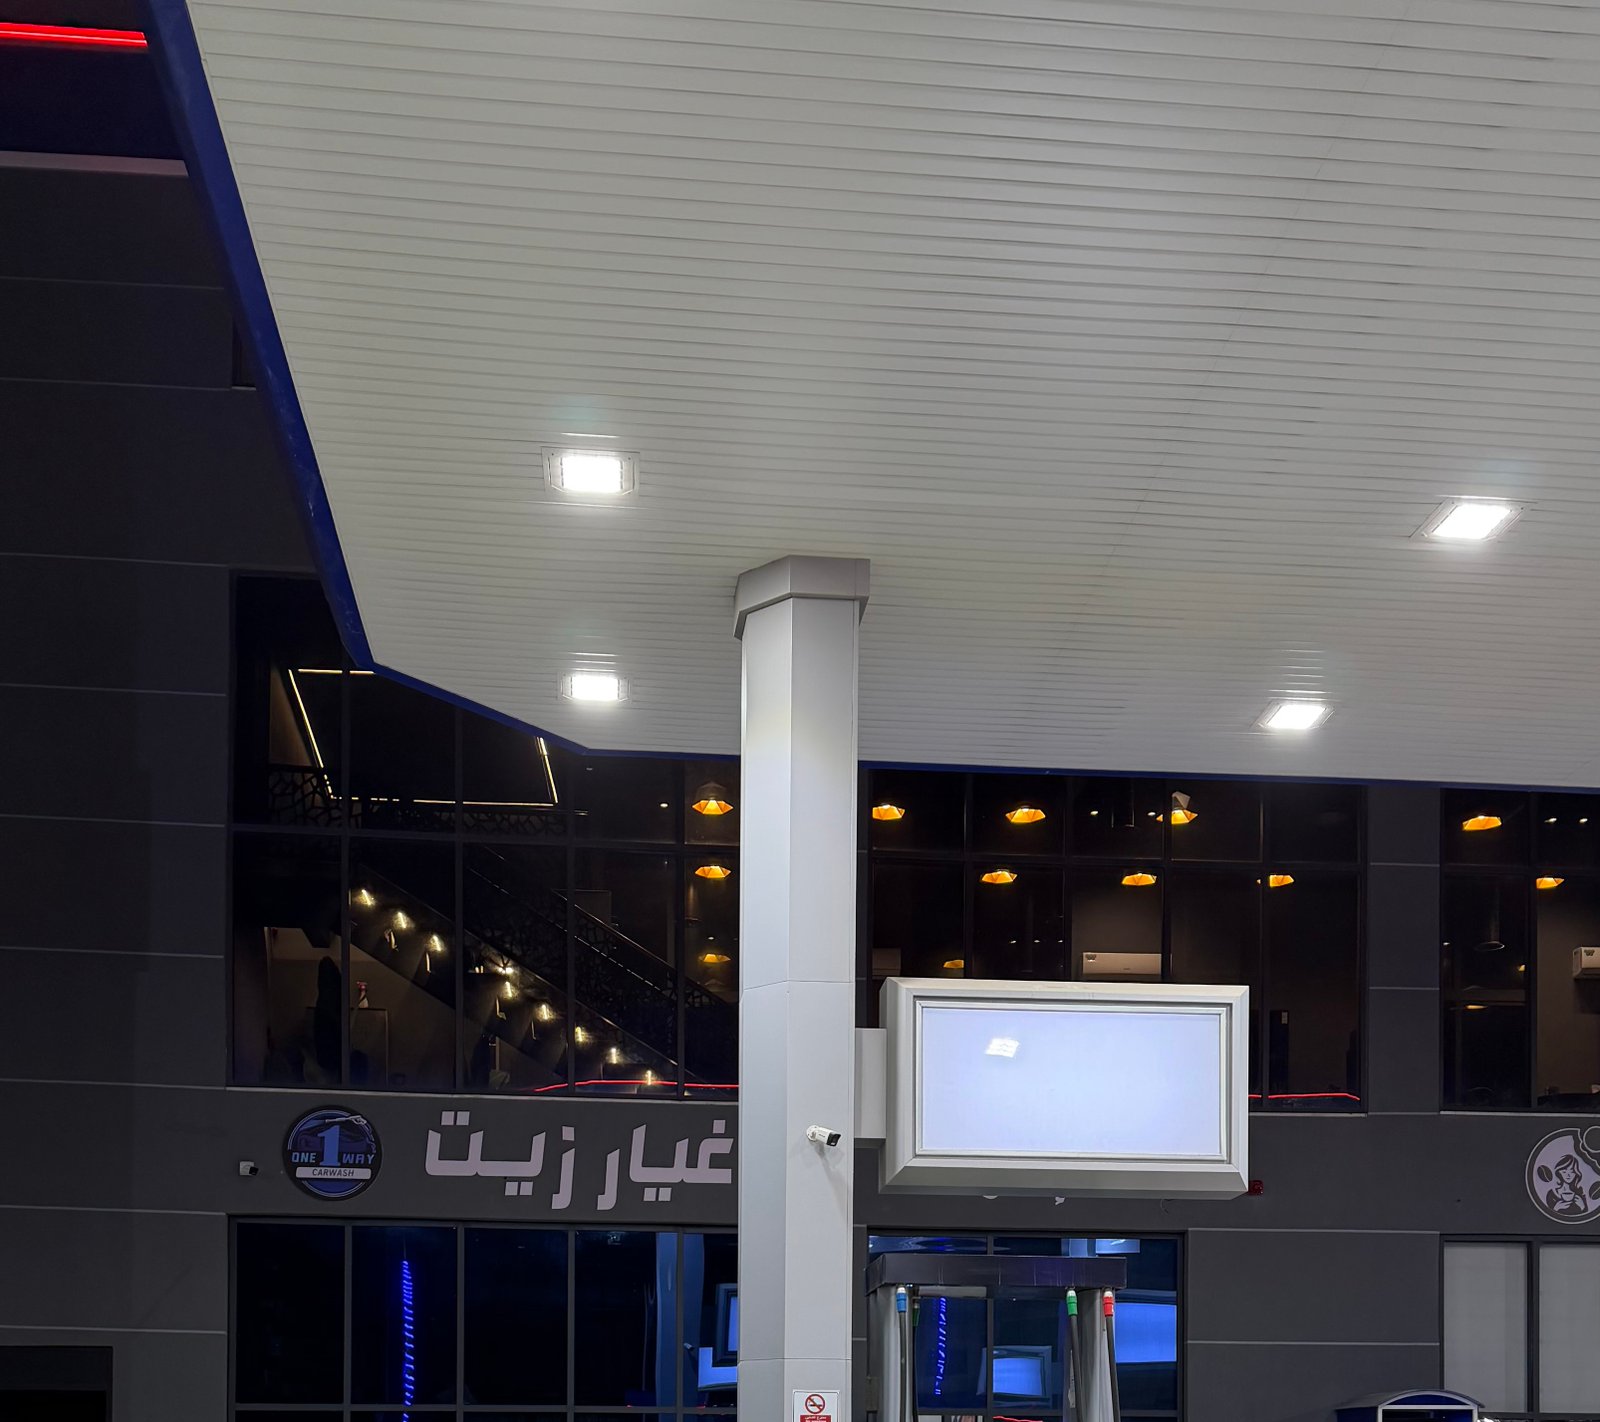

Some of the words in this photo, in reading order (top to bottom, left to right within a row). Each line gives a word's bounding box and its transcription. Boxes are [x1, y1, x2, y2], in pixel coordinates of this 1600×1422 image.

[291, 1152, 317, 1163] ONE
[317, 1124, 341, 1166] 1
[342, 1153, 375, 1165] WAY
[312, 1168, 355, 1177] CARWASH
[424, 1110, 575, 1210] زيت
[597, 1119, 734, 1210] غيار
